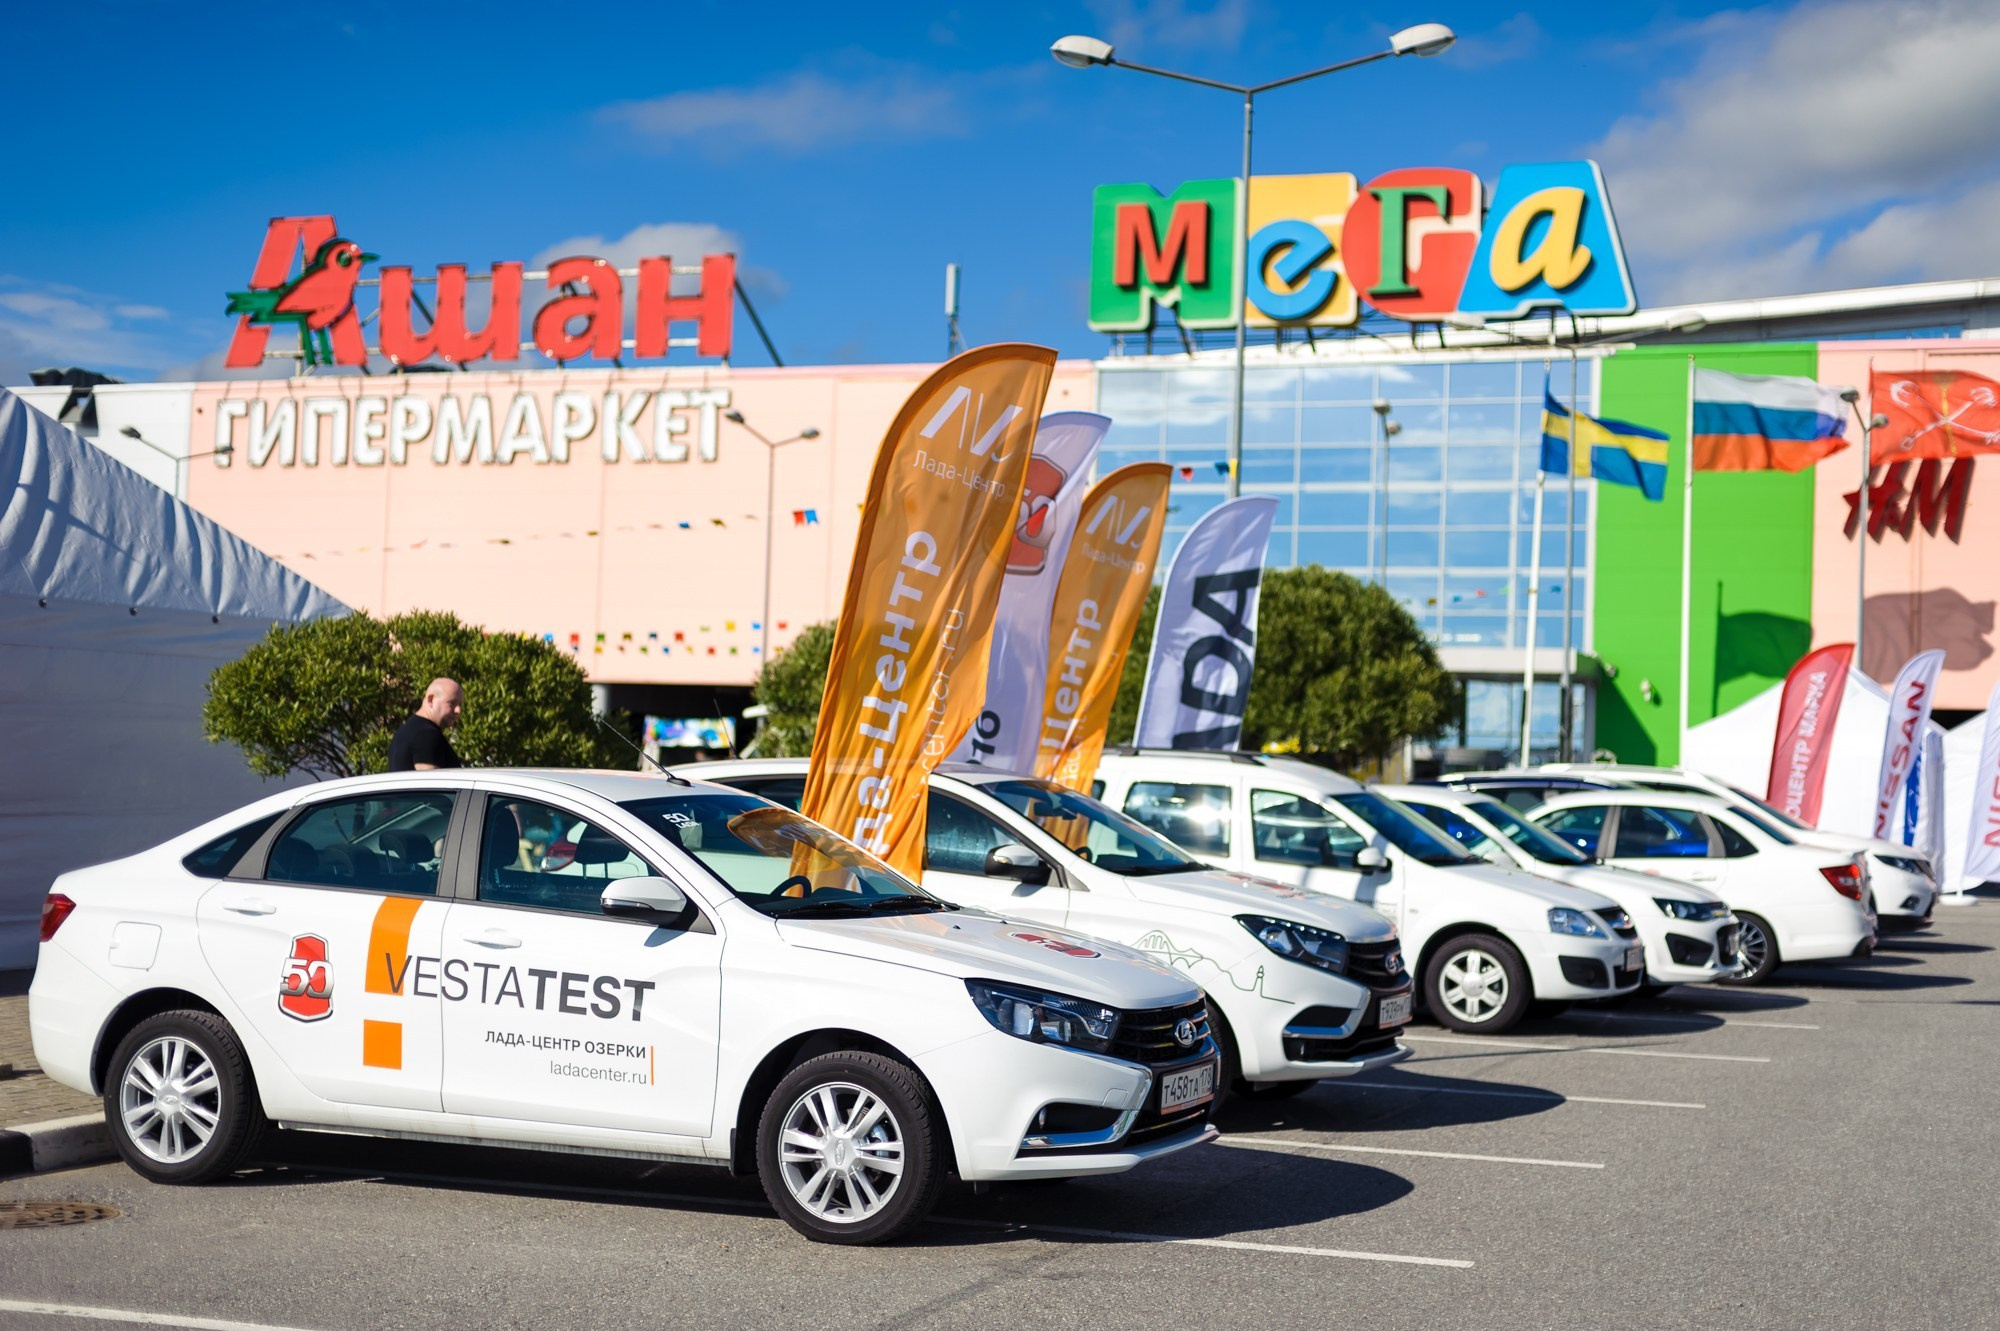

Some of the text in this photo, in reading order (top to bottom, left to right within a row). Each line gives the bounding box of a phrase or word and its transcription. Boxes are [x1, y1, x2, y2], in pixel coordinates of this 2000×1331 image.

[224, 215, 737, 368] Ашан
[213, 388, 732, 468] ГИПЕРМАРКЕТ
[912, 449, 1006, 498] Лада-Центр
[852, 530, 942, 856] да-Центр
[1040, 597, 1101, 750] Центр
[1171, 567, 1261, 750] DA
[965, 710, 1001, 766] 16
[1874, 680, 1927, 840] NISSAN
[280, 957, 334, 1000] 50
[385, 952, 656, 1022] VESTATEST
[484, 1030, 647, 1059] ЛАДА-ЦЕНТР ОЗЕРКИ
[549, 1060, 647, 1085] ladacenter.ru
